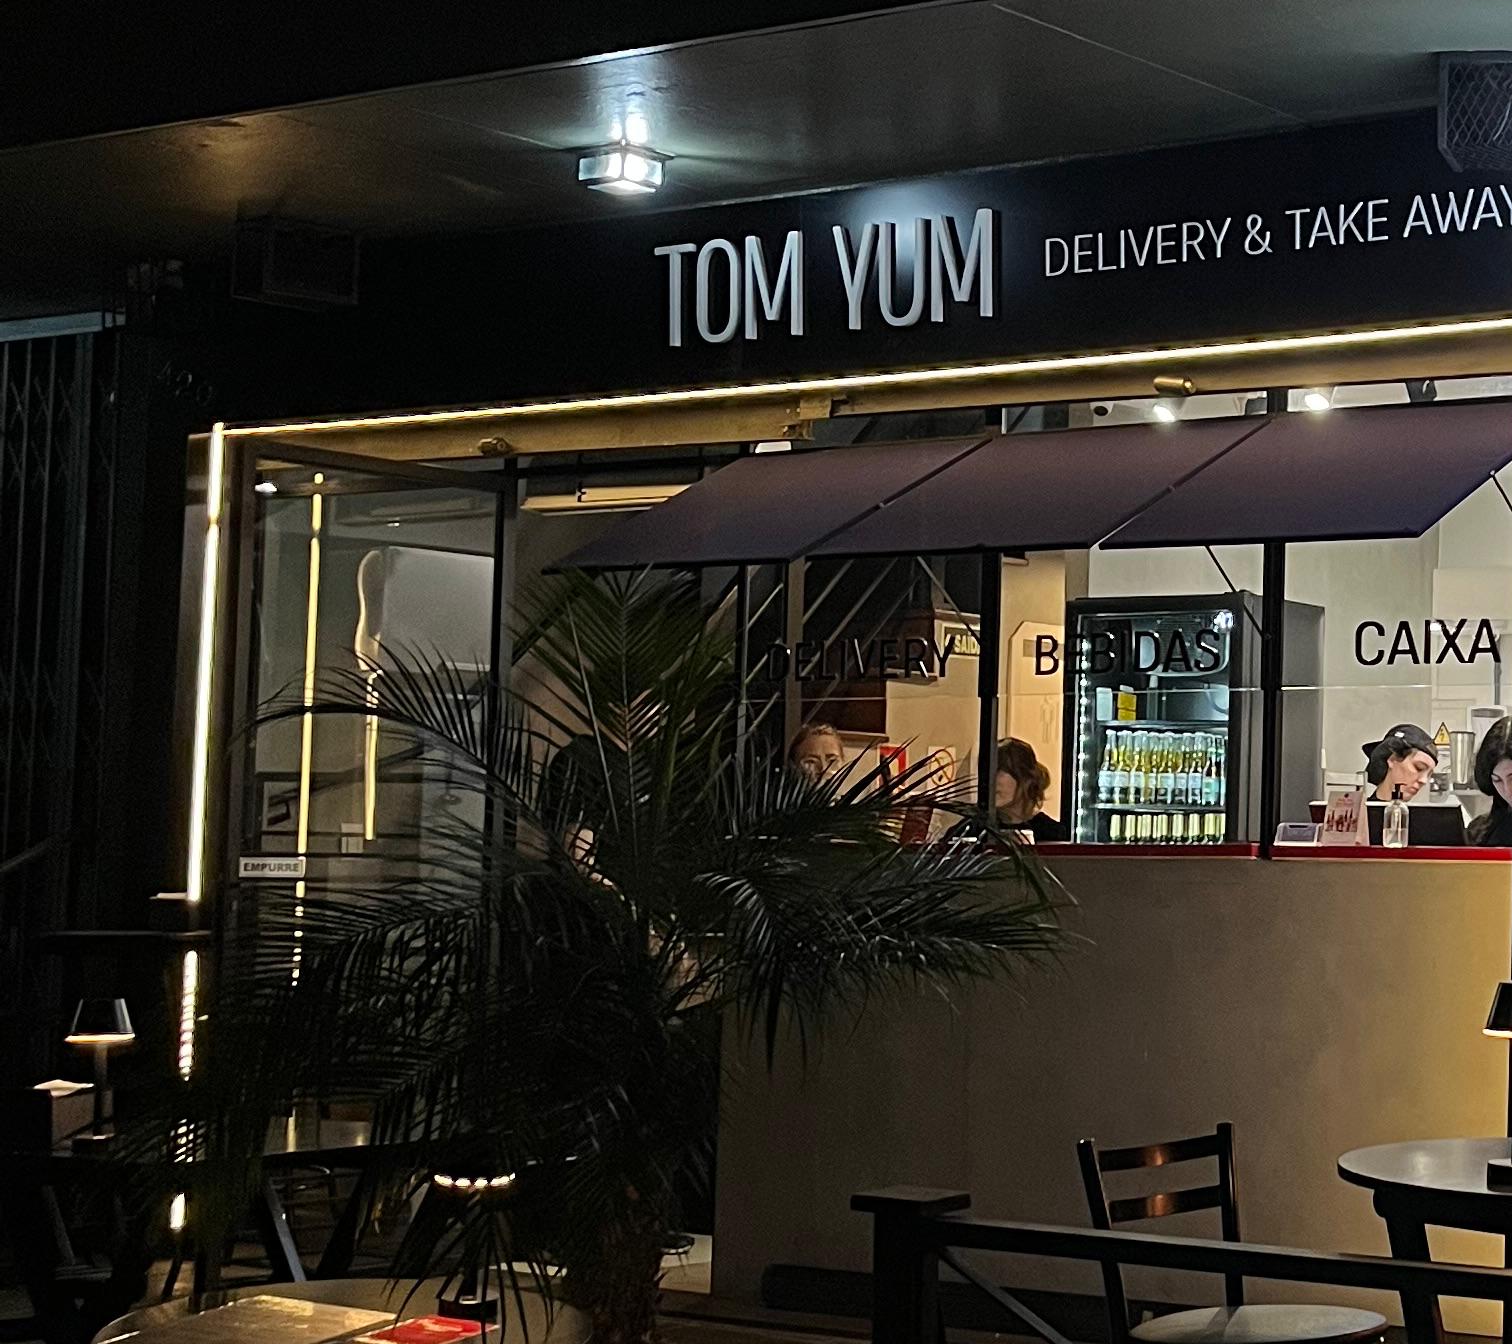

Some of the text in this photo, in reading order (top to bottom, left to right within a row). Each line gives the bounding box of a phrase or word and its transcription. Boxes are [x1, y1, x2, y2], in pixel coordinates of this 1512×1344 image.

[1044, 216, 1232, 277] DELIVERY
[1243, 213, 1274, 256] &
[1285, 198, 1390, 250] TAKE
[654, 208, 994, 347] TOM YUM
[766, 634, 956, 682] DELIVERY
[1034, 628, 1221, 676] BEBIDAS
[1355, 618, 1501, 666] CAIXA
[243, 862, 300, 873] EMPURRE
